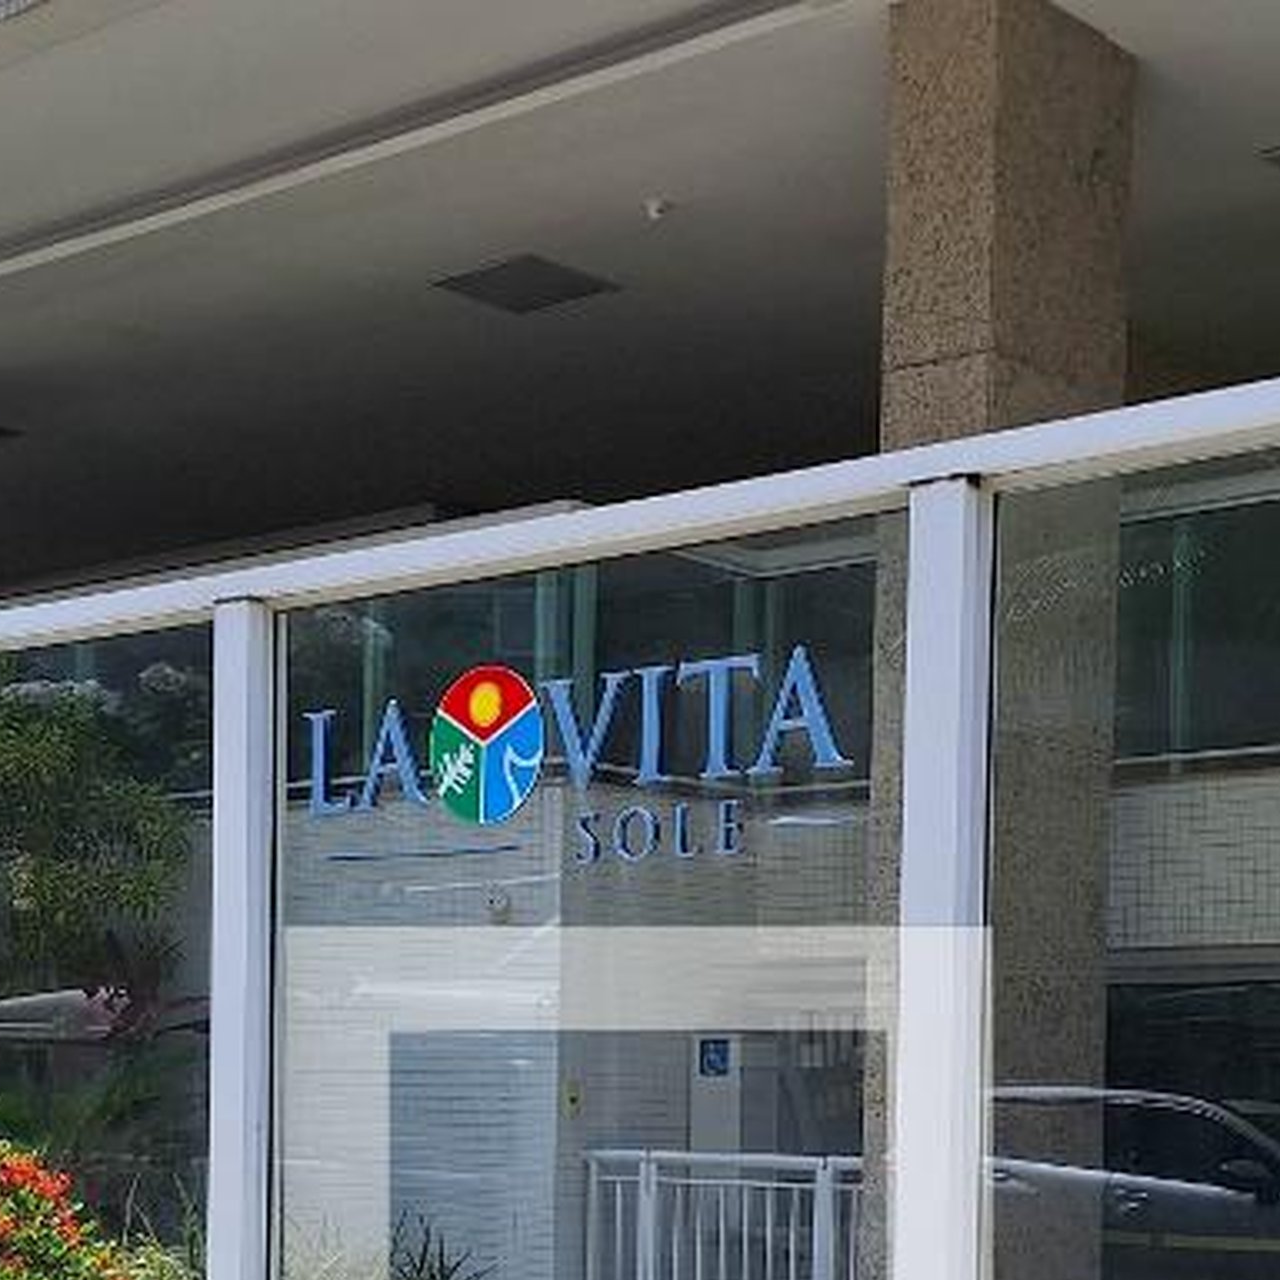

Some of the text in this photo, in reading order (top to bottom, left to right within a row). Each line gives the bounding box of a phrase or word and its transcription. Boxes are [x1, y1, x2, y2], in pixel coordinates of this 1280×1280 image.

[301, 644, 854, 818] LA VITA
[575, 799, 748, 866] SOLE
